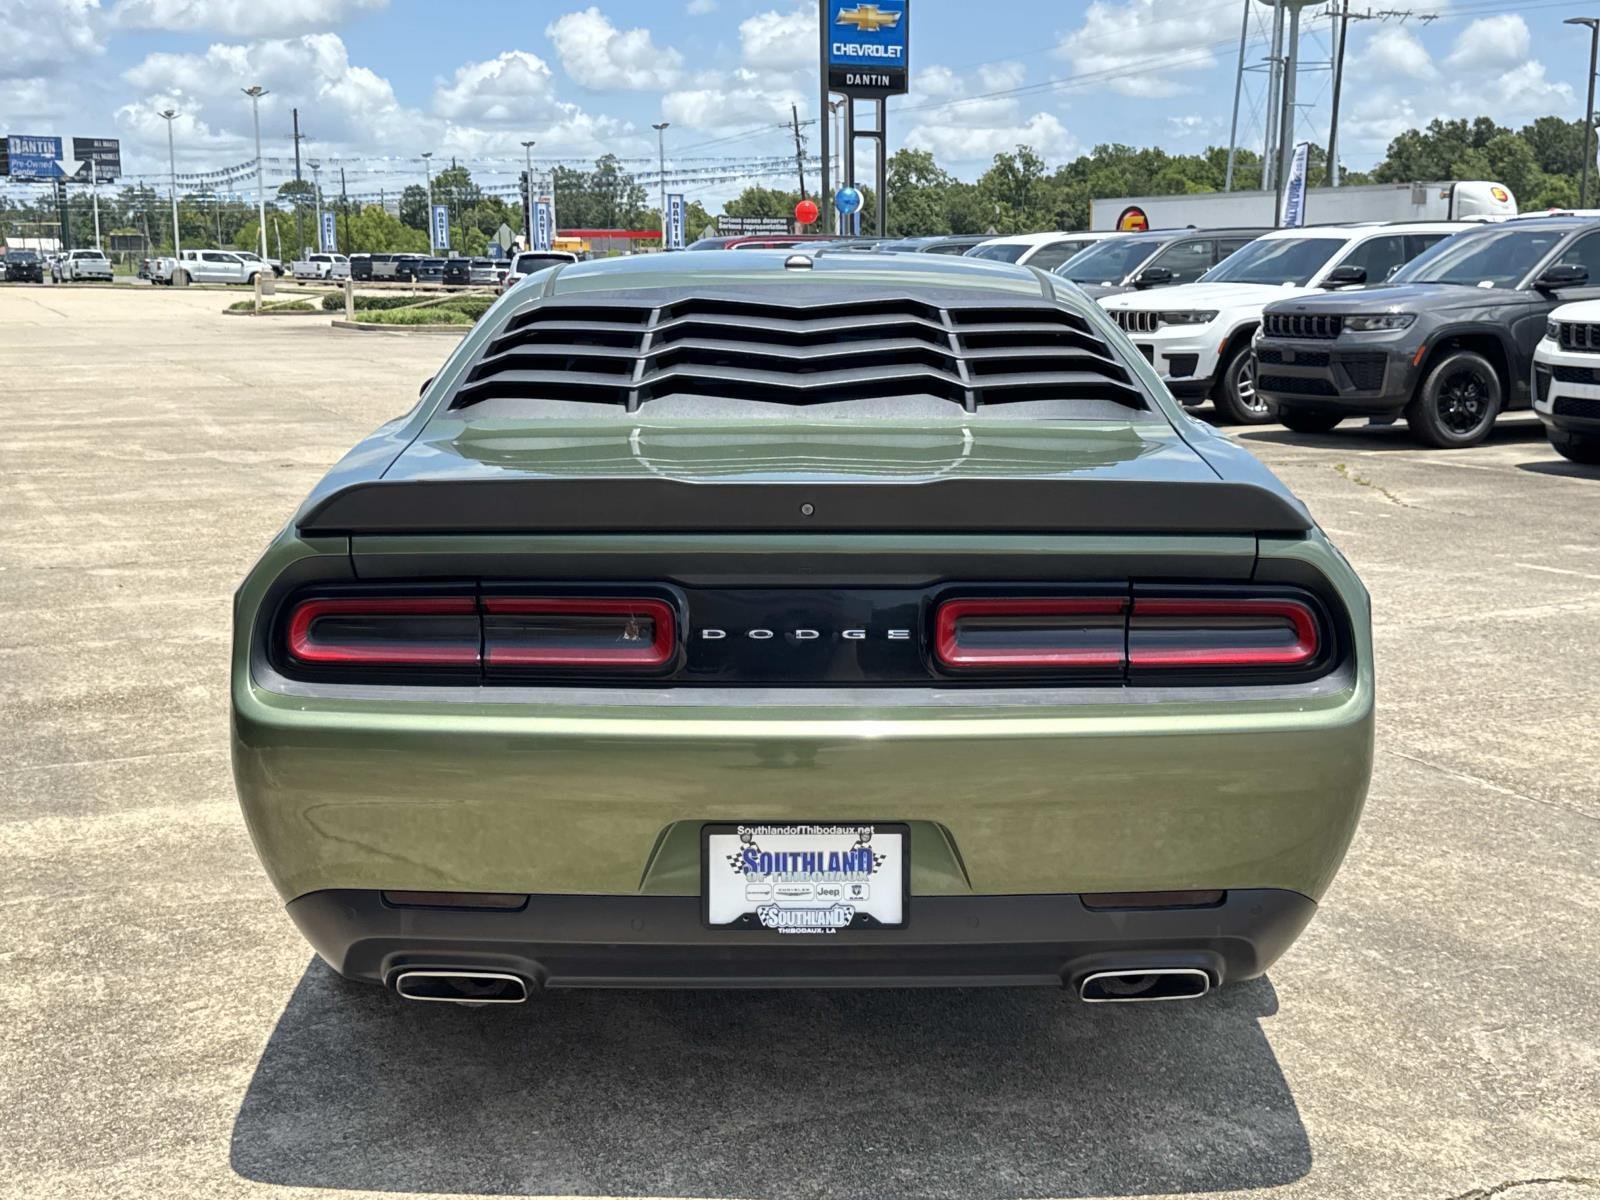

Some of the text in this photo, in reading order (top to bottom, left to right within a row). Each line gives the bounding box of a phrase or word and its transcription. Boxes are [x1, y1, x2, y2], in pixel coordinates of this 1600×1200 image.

[833, 43, 903, 58] CHEVROLET
[846, 74, 890, 87] DANTIN
[10, 138, 56, 154] DANTIN
[12, 160, 53, 169] Pre-Owned
[438, 212, 446, 248] DANTIN
[539, 208, 547, 249] DANTIN
[673, 202, 681, 248] DANTIN
[702, 629, 911, 640] DODGE
[737, 825, 875, 835] SouthlandofThibodaux.net
[742, 848, 874, 876] SOUTHLAND
[746, 871, 870, 883] OF THIBODAUX
[817, 888, 840, 897] Jeep
[768, 908, 846, 926] SOUTHLAND
